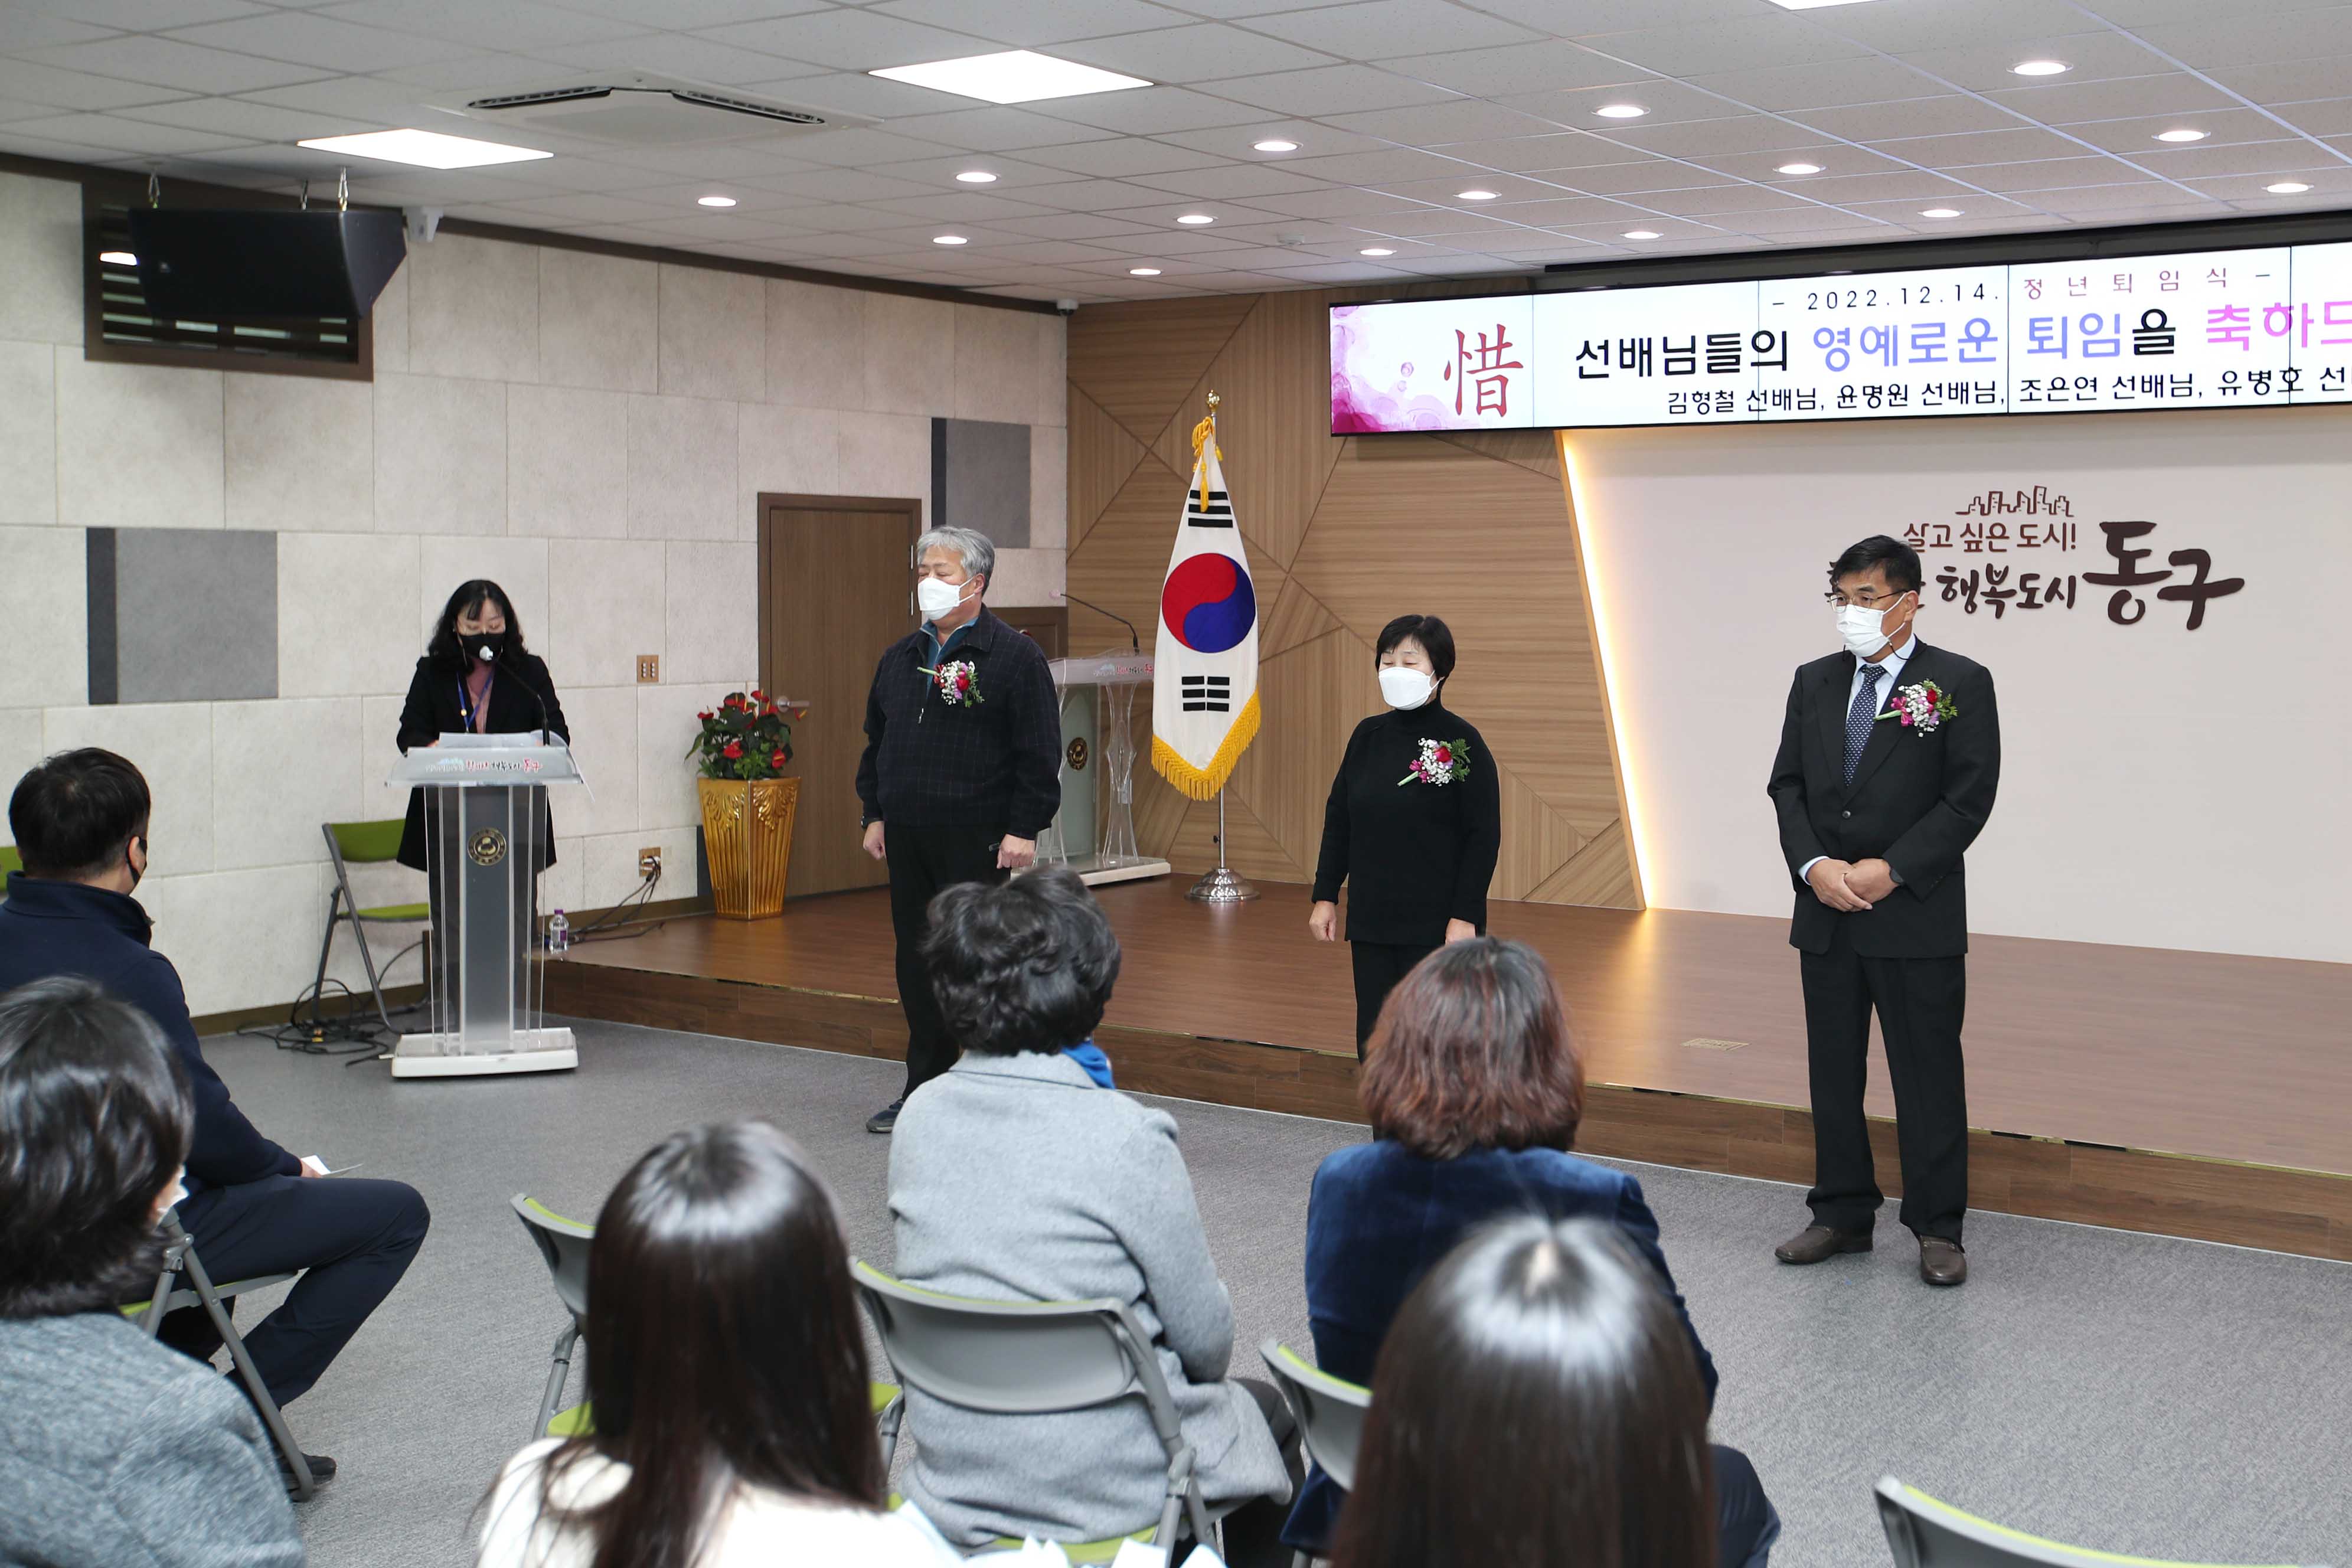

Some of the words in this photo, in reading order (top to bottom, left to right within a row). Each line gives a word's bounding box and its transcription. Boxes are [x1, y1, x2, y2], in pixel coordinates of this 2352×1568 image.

[1808, 283, 1998, 311] 2022.12.14.
[1444, 324, 1524, 417] 惜
[1576, 331, 1788, 379] 선배님들의
[1814, 318, 1998, 372] 영예로운
[2027, 308, 2176, 360] 퇴임을
[1668, 390, 1734, 415] 김형철
[1746, 388, 1825, 412] 선배님,
[1837, 383, 1908, 409] 윤명원
[1921, 380, 2005, 406] 선배님,
[2020, 376, 2098, 402] 조은연
[2112, 373, 2203, 400] 선배님,
[2217, 367, 2304, 396] 유병호
[2320, 367, 2352, 392] 선
[1903, 522, 1954, 553] 살고
[1959, 522, 2010, 553] 싶은
[2016, 522, 2076, 553] 도시!
[1935, 563, 2077, 620] 행복도시
[2082, 521, 2245, 631] 동구
